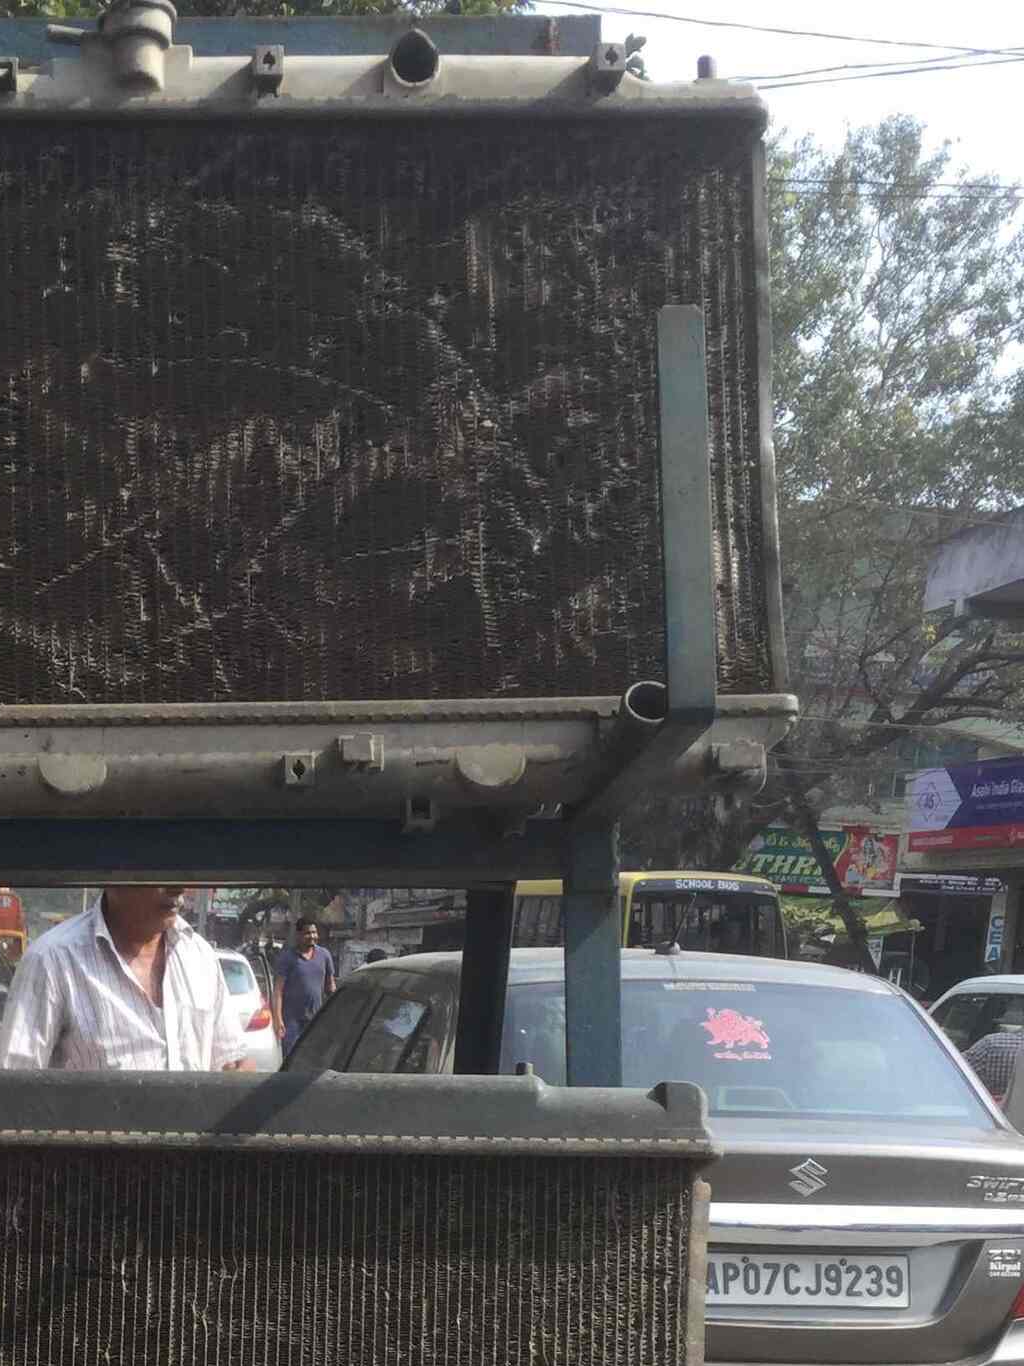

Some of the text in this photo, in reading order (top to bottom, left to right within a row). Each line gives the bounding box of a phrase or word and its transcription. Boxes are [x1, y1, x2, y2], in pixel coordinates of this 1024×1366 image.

[675, 879, 741, 892] SCHOOL BUS
[706, 1261, 904, 1298] AP07CJ9239
